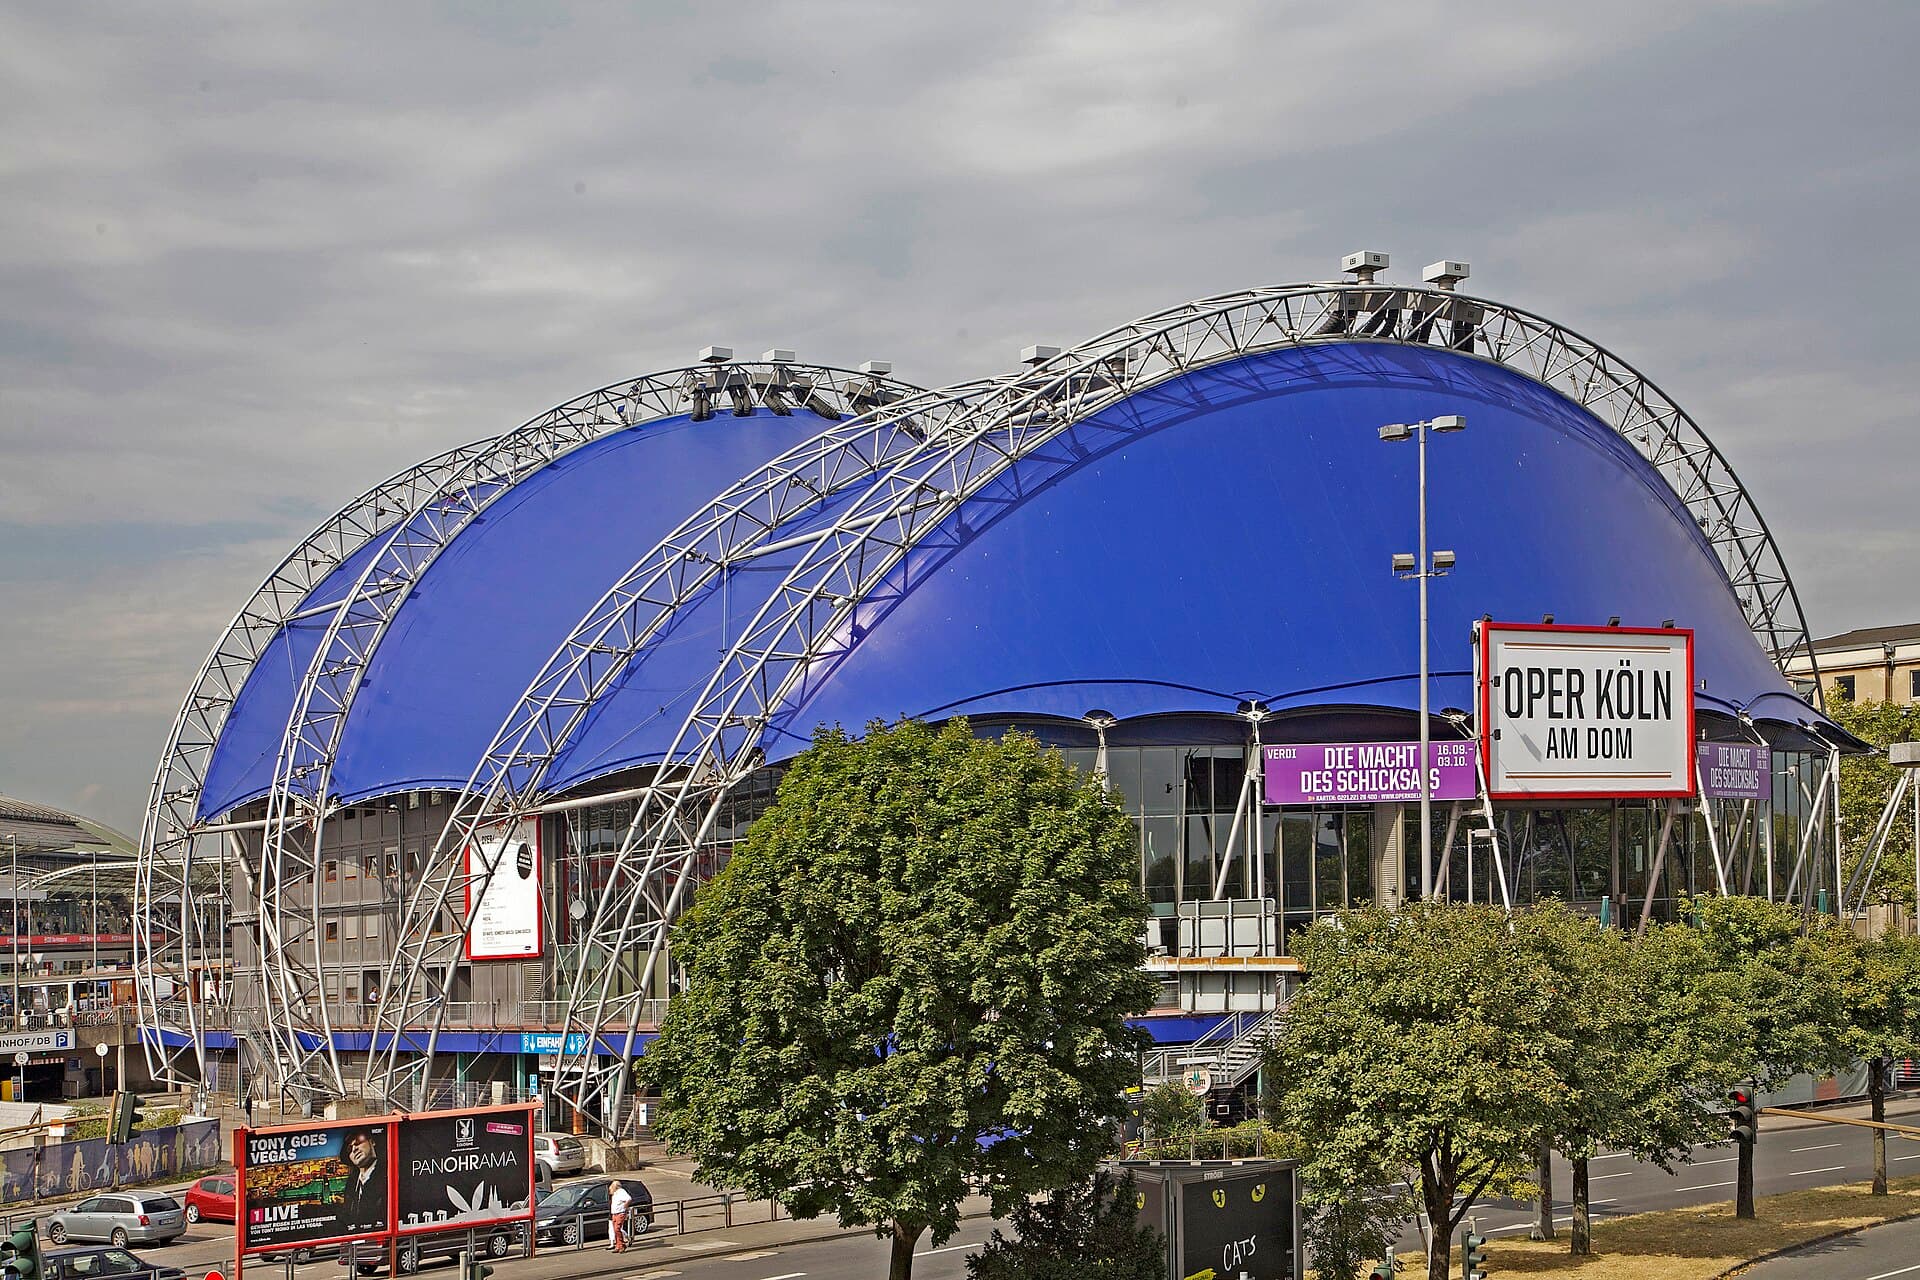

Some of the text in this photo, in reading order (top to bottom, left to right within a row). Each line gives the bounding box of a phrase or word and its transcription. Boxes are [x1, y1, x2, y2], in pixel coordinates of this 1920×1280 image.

[1504, 659, 1672, 720] OPER KÖLN
[1546, 727, 1632, 759] AM DOM
[1267, 748, 1297, 760] VERDI
[1324, 746, 1417, 769] DIE MACHT
[1437, 756, 1468, 767] 03.10.
[1718, 747, 1750, 768] DIE MACHT
[1301, 768, 1440, 793] DES SCHICKSAS
[1710, 768, 1759, 789] DES SCHICKSALS
[536, 1036, 567, 1048] EINFAH
[250, 1133, 328, 1152] TONY GOES
[250, 1148, 297, 1164] VEGAS
[412, 1150, 518, 1177] PANOHRAMA
[1223, 1234, 1257, 1271] CATS
